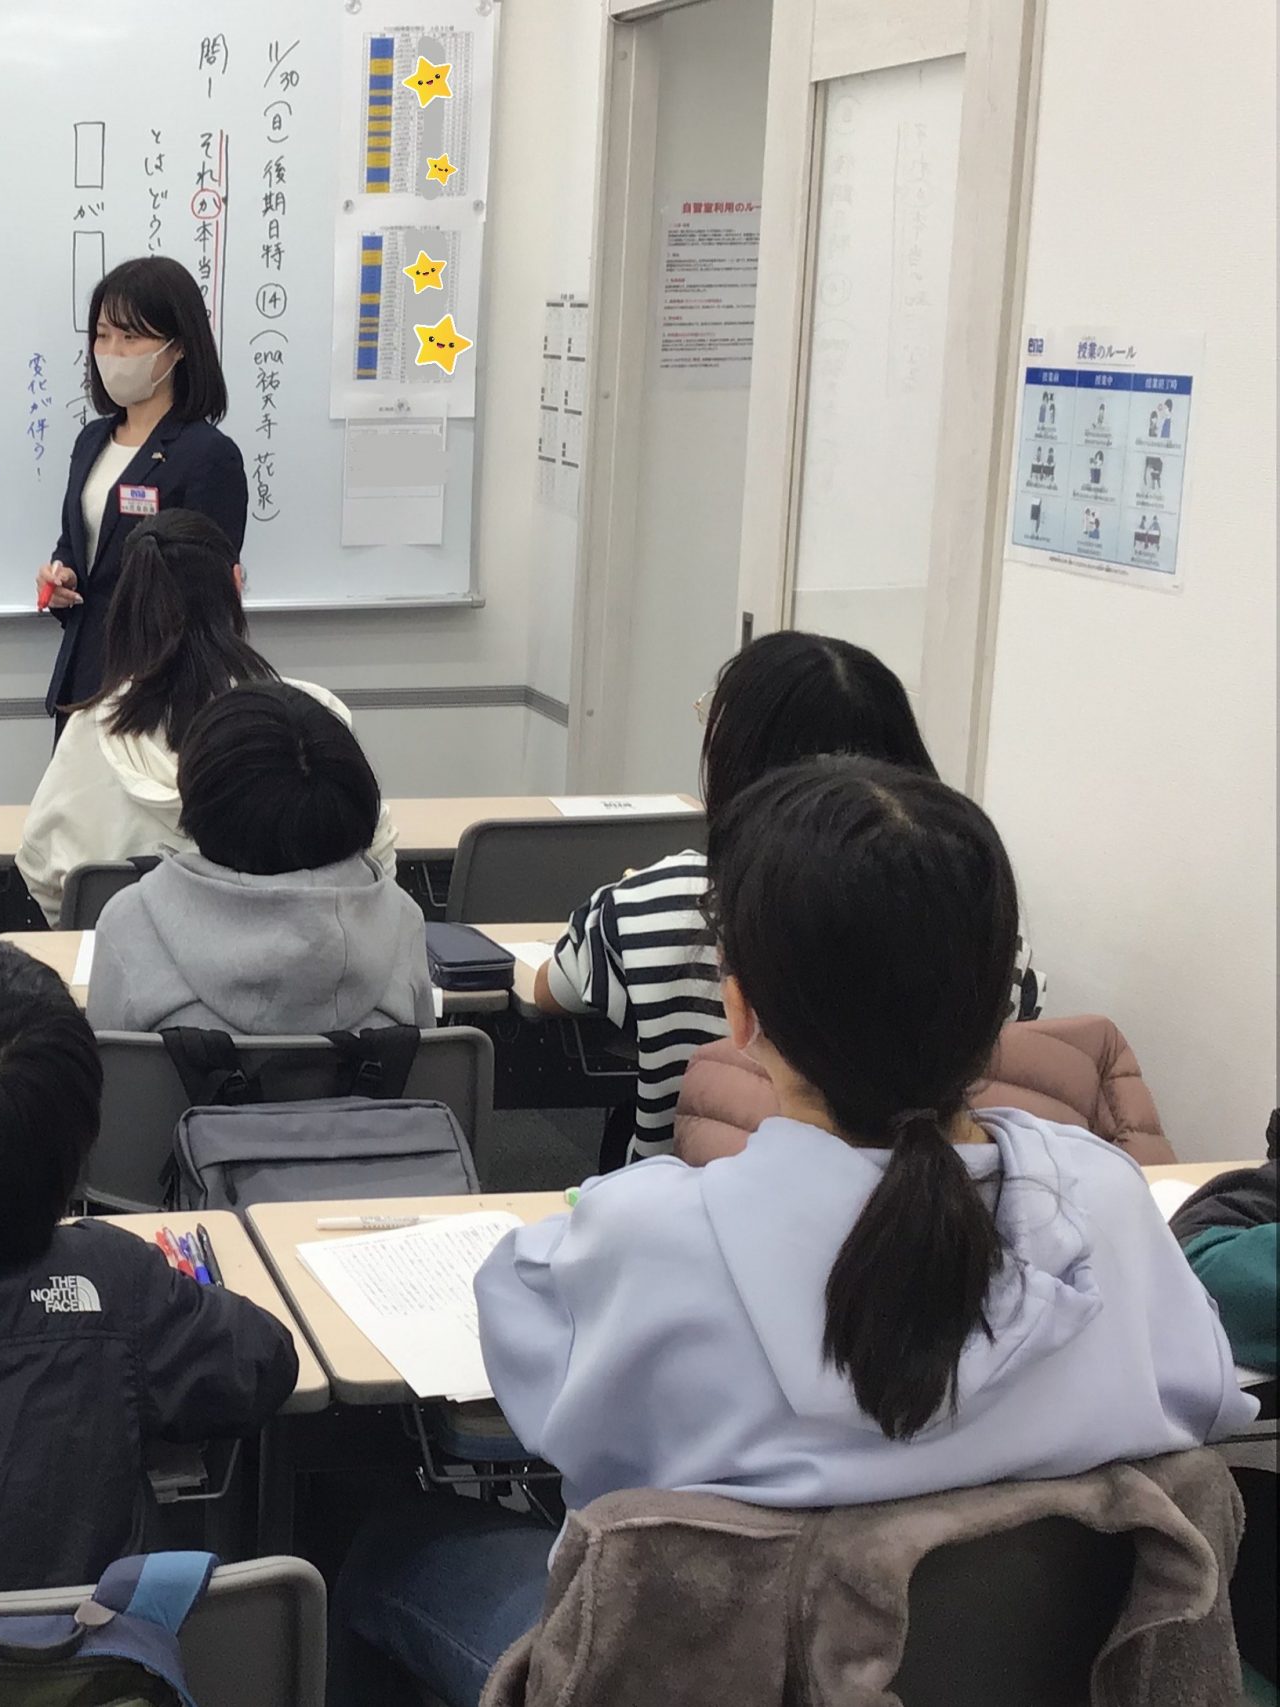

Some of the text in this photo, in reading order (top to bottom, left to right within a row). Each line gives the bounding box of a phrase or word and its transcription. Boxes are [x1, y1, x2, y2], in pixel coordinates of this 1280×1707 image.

[144, 128, 169, 258] とはどうい
[1077, 341, 1137, 361] 授業のルール
[49, 1275, 77, 1288] THE
[30, 1287, 77, 1302] NORTH
[45, 1300, 79, 1313] FACE
